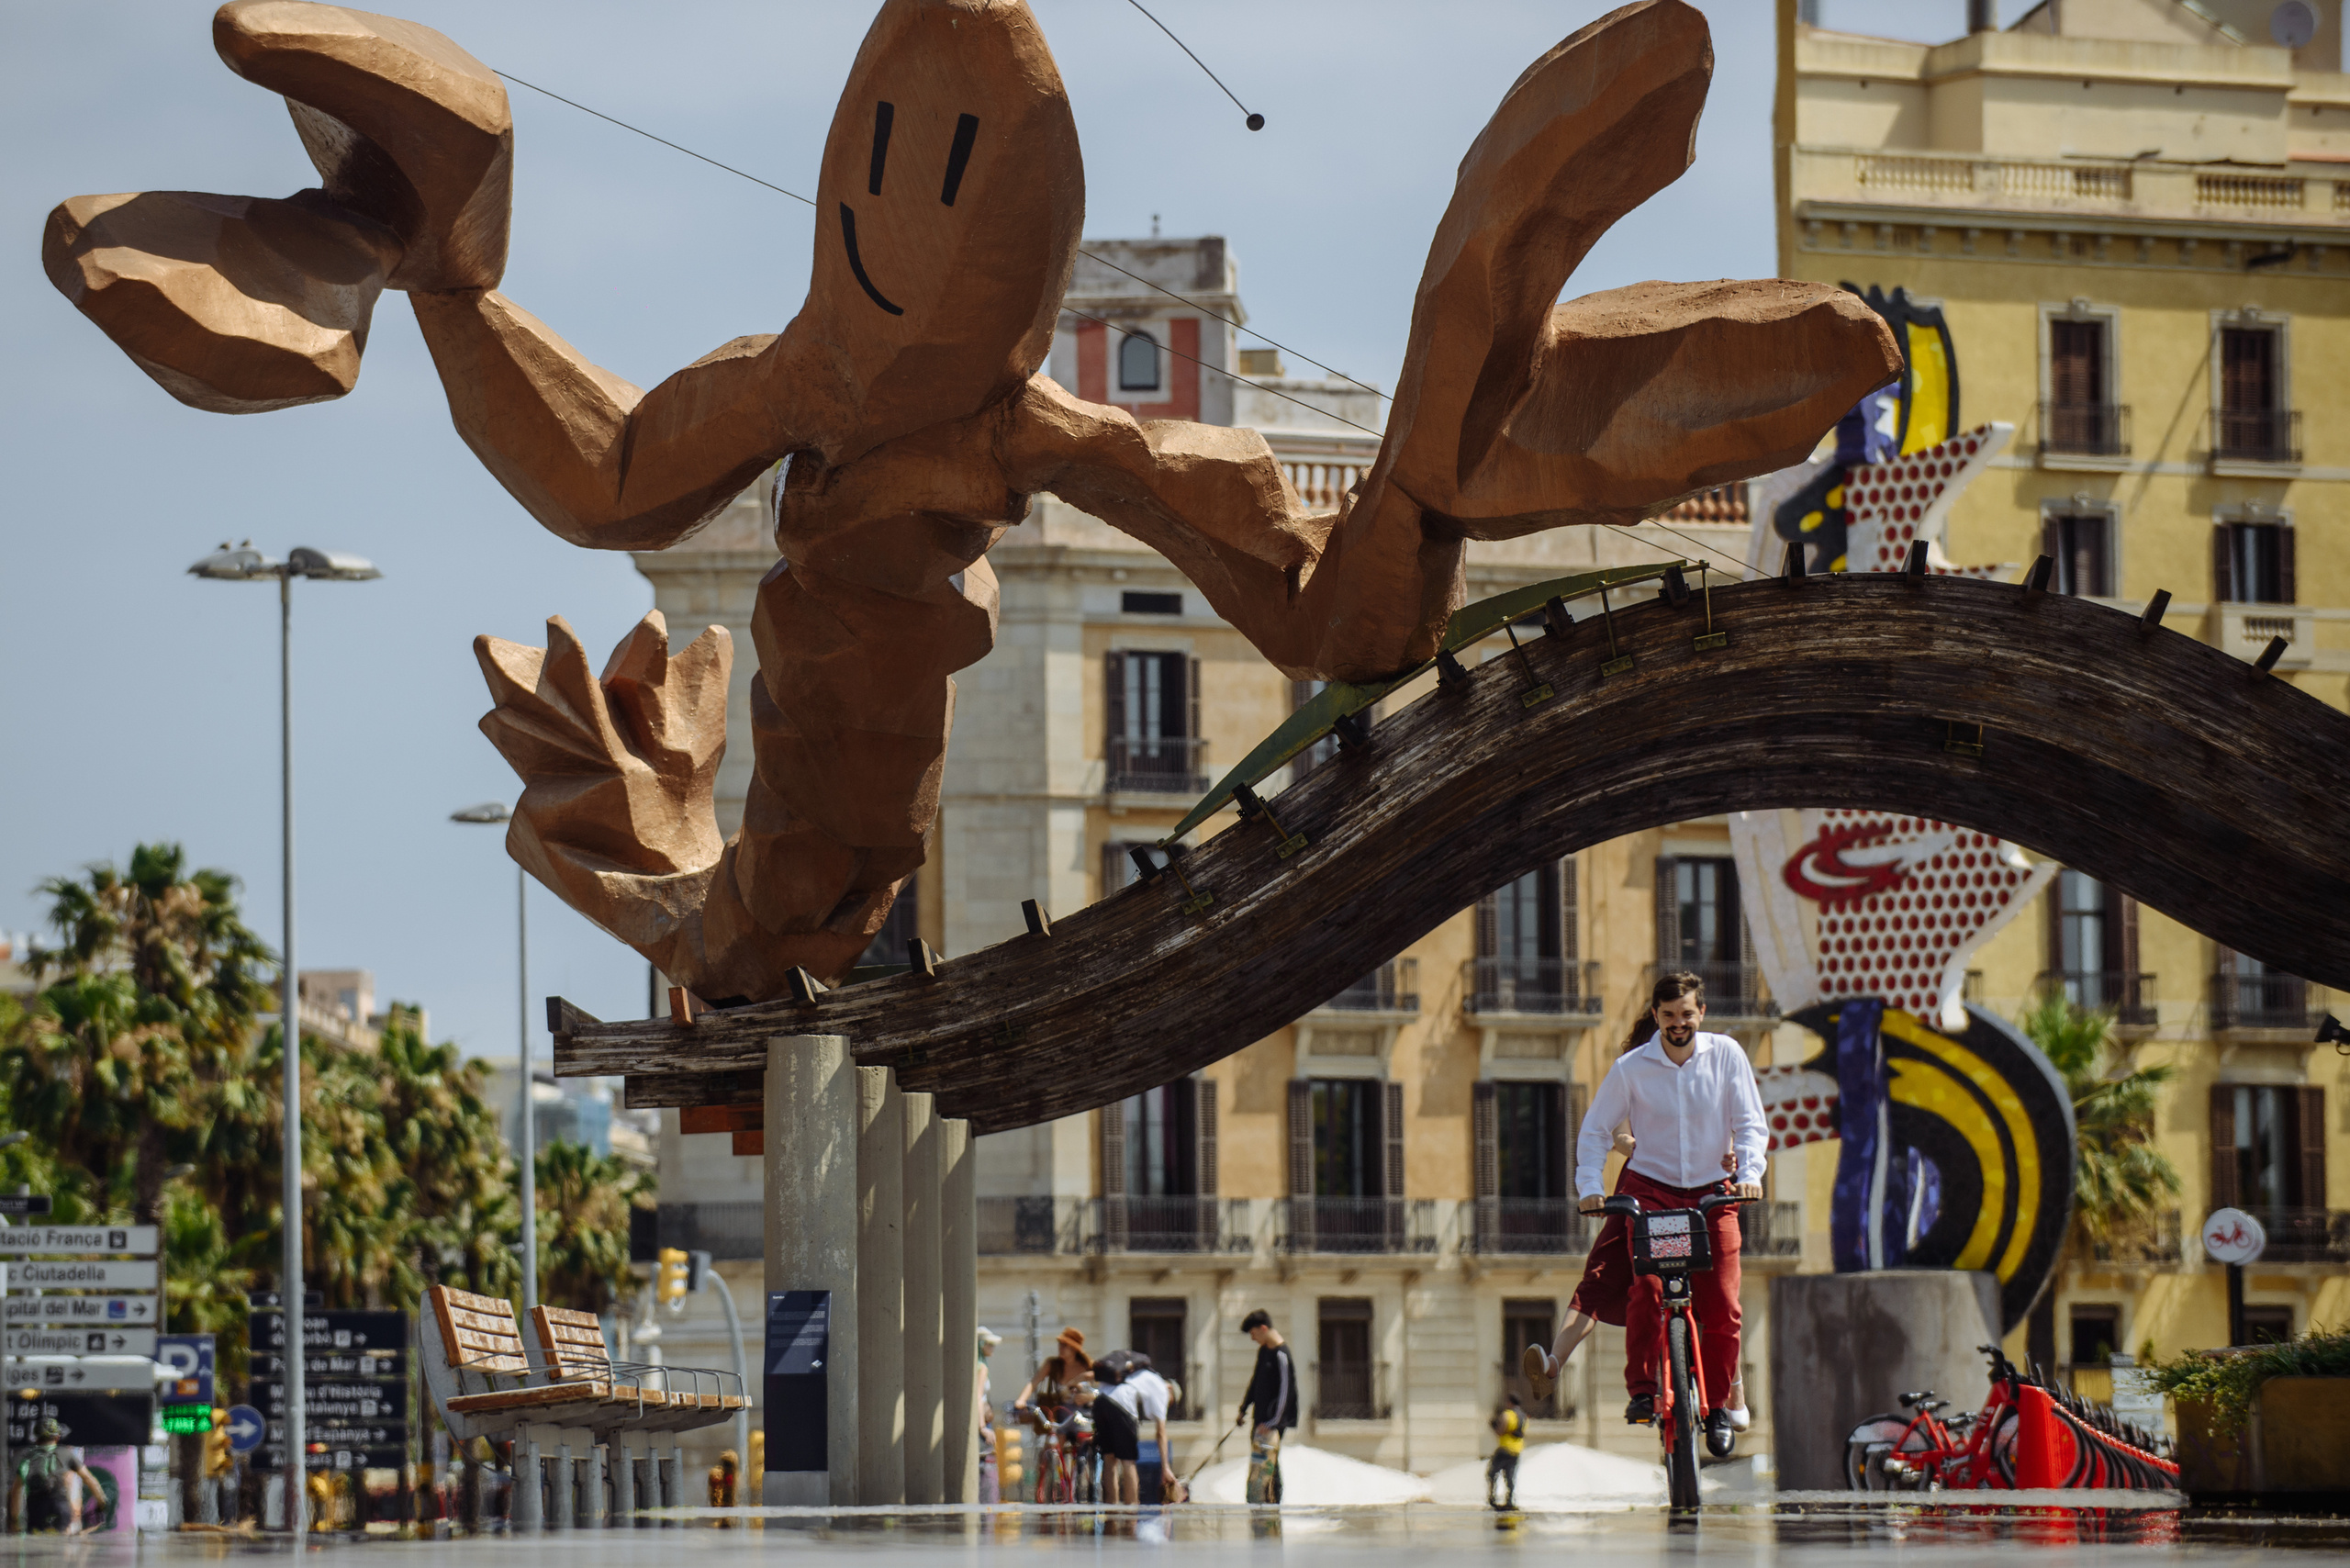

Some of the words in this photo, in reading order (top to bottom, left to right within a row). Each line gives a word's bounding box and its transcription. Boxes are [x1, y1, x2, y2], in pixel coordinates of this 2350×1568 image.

[46, 1229, 103, 1248] França
[23, 1264, 106, 1281] Ciutadella
[46, 1300, 67, 1316] del
[73, 1300, 101, 1316] Mar
[160, 1343, 199, 1397] P
[18, 1401, 39, 1419] de
